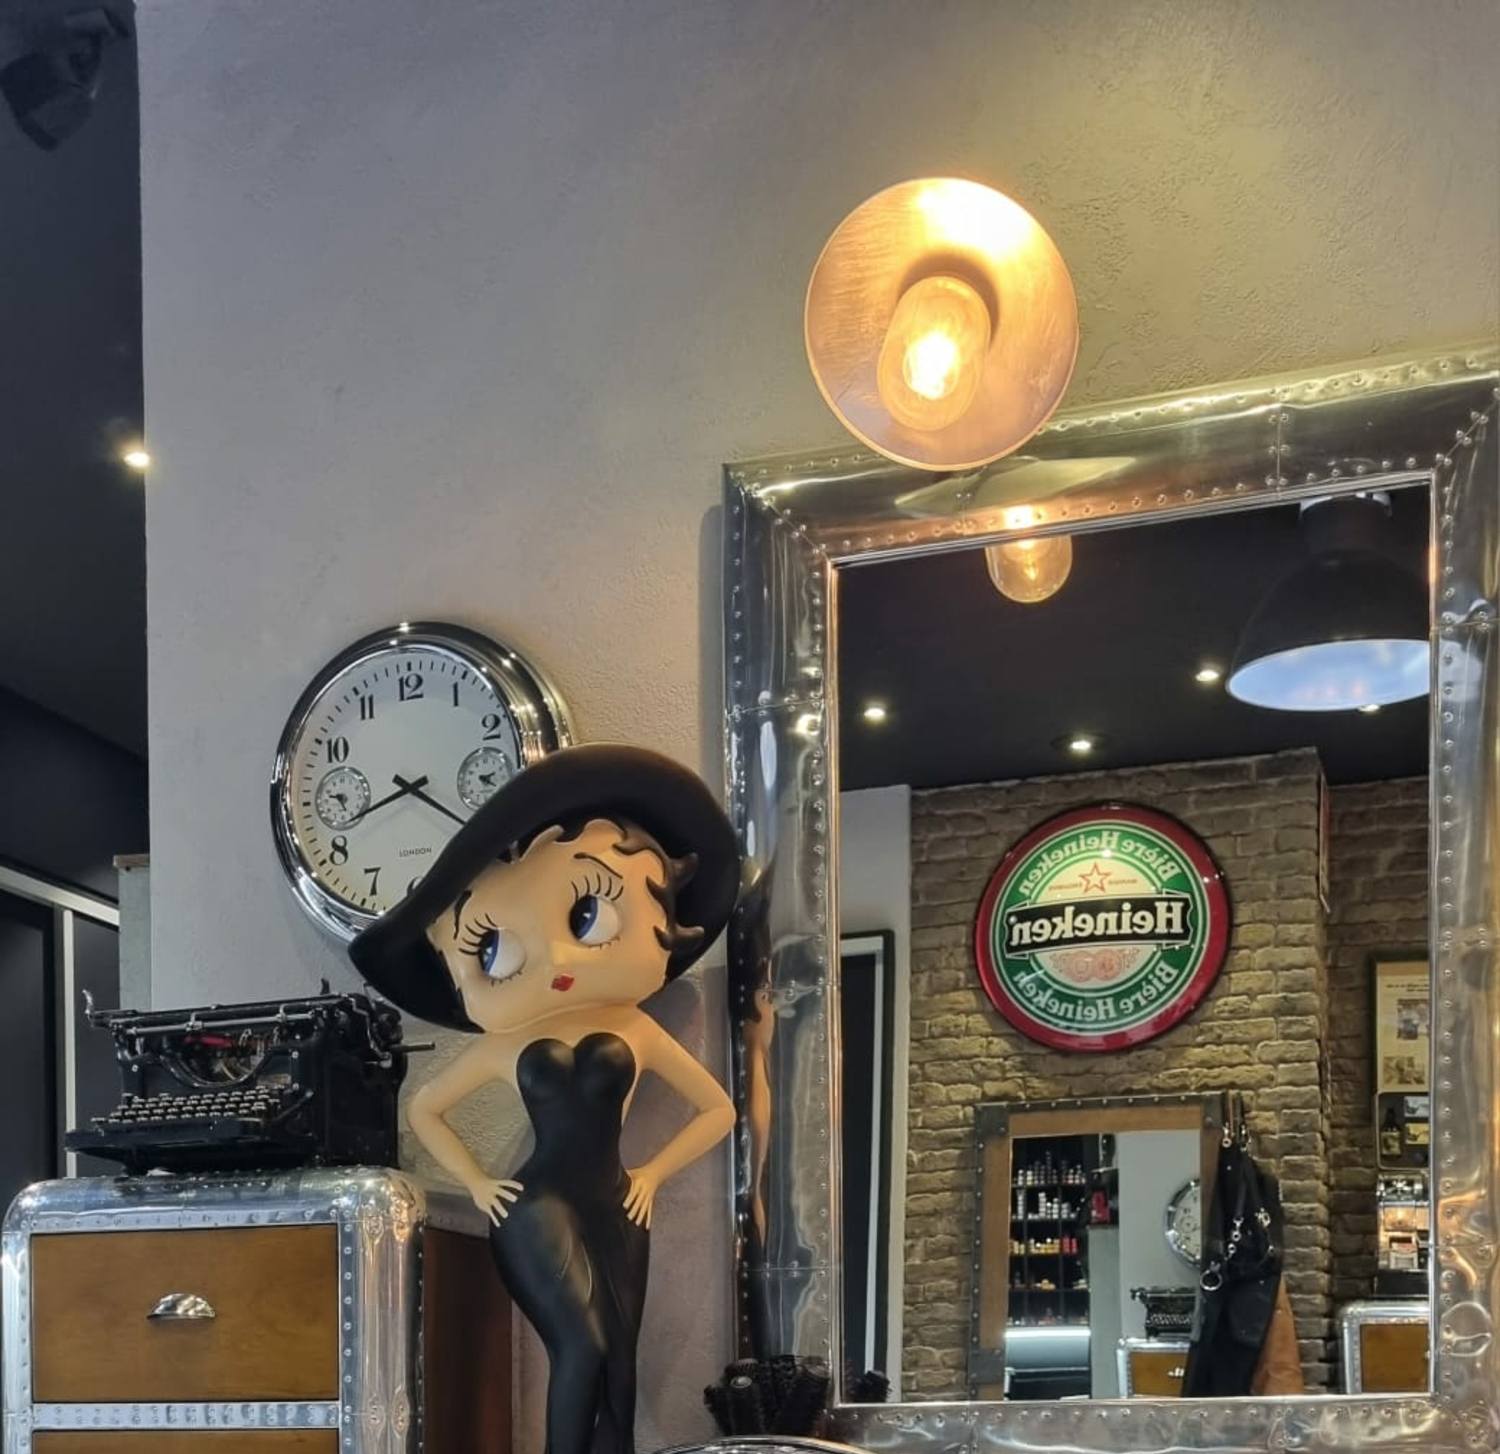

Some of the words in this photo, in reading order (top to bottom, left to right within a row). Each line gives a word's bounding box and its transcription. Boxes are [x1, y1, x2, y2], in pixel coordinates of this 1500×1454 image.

[399, 673, 424, 701] 12
[452, 683, 460, 707] 1
[360, 694, 375, 720] 11
[482, 714, 501, 740] 2
[326, 737, 349, 763] 10
[330, 835, 348, 865] 8
[399, 847, 432, 857] LONDON
[364, 866, 382, 896] 7
